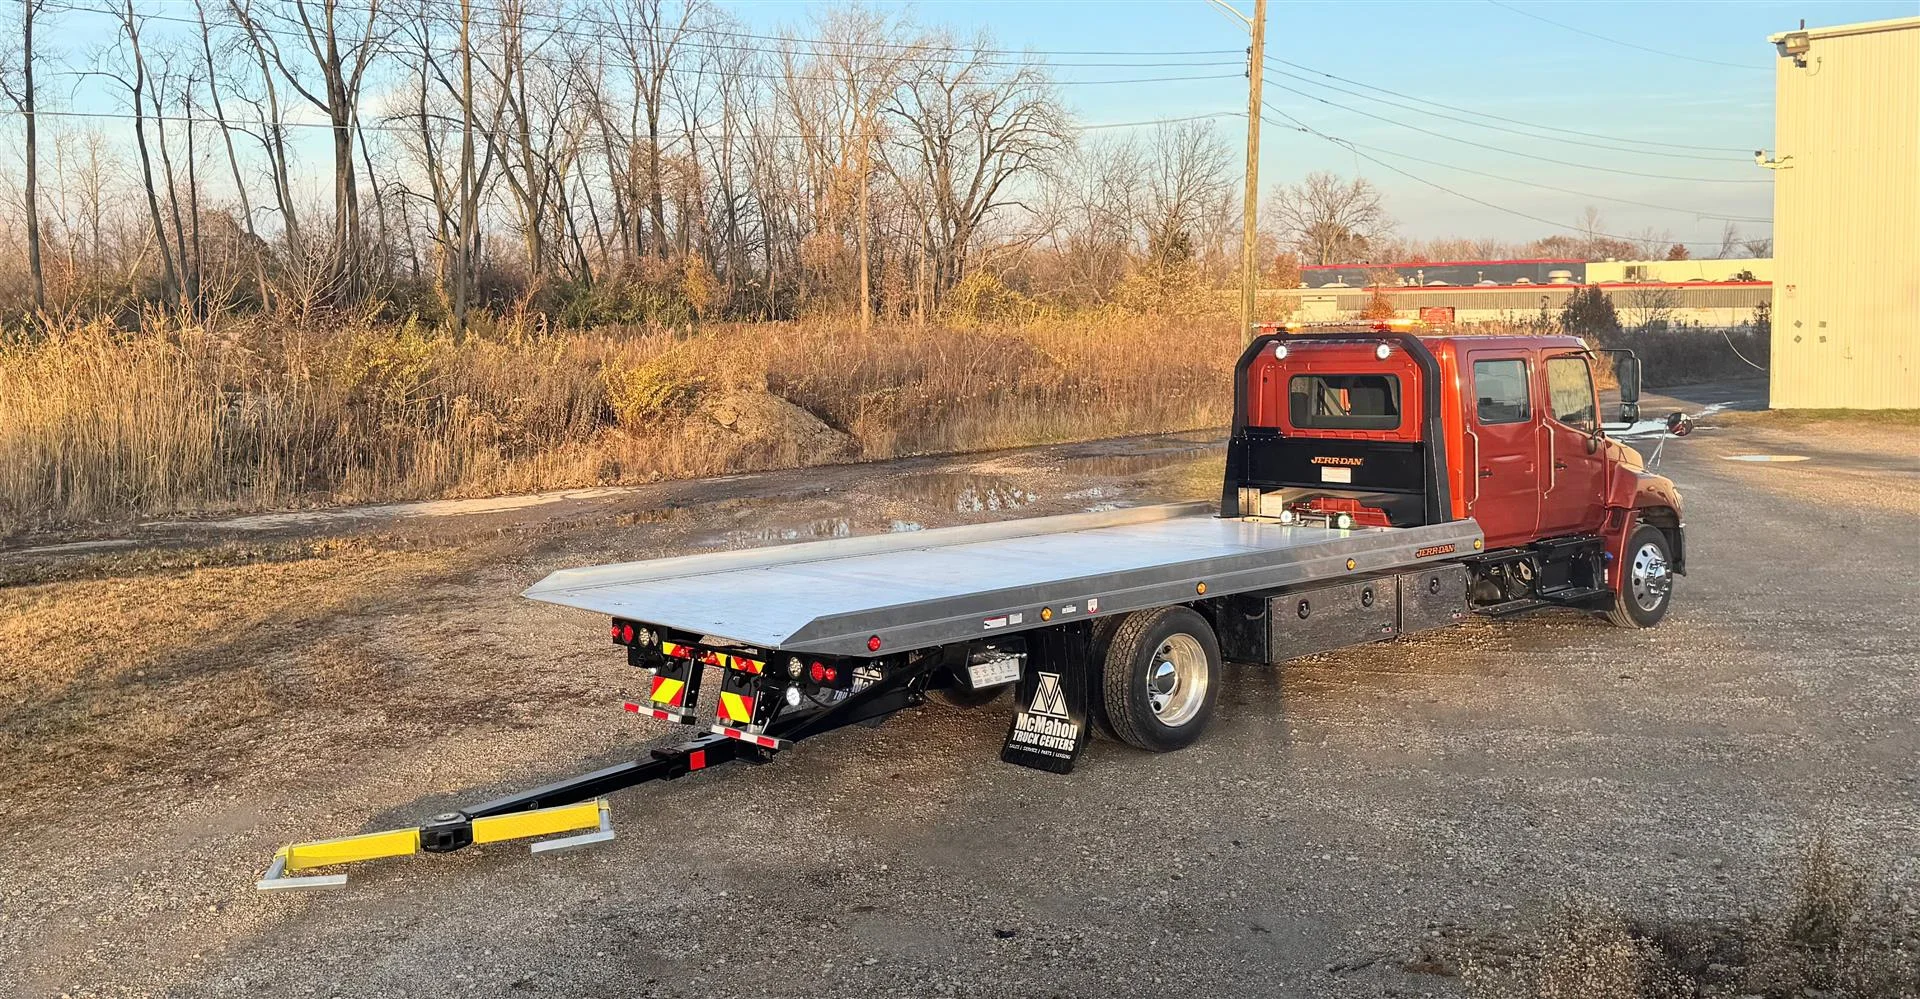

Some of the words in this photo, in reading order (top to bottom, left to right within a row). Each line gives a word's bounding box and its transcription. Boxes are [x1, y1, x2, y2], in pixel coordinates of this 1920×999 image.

[1015, 712, 1078, 740] McMahon
[1012, 730, 1040, 745] TRUCK
[1039, 734, 1075, 752] CENTERS
